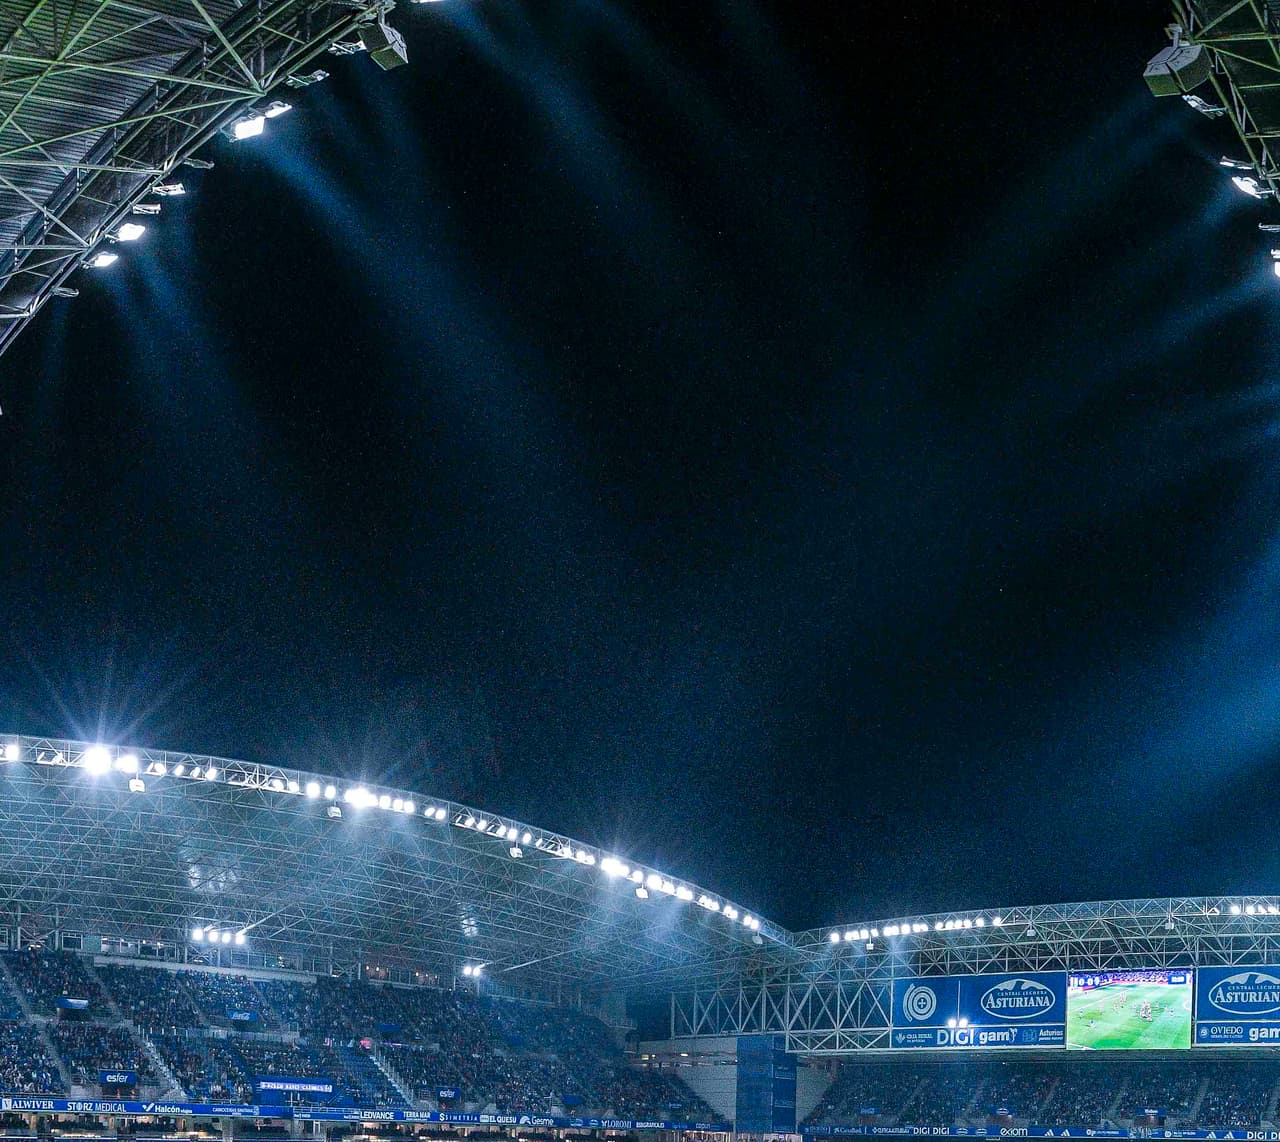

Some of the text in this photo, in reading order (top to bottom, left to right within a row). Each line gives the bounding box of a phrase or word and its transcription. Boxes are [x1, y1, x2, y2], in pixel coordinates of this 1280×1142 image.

[986, 993, 1050, 1009] ASTURIANA
[1210, 1026, 1243, 1034] OVIEDO
[937, 1029, 975, 1045] DIGI
[106, 1073, 128, 1083] esfer
[2, 1100, 54, 1110] VALWIVER
[95, 1103, 127, 1113] MEDICAL
[154, 1104, 181, 1113] Halcón
[360, 1111, 394, 1119] LEDVANCE
[913, 1127, 930, 1135] DIGI
[932, 1127, 950, 1135] DIGI
[1246, 1131, 1267, 1140] DIGI
